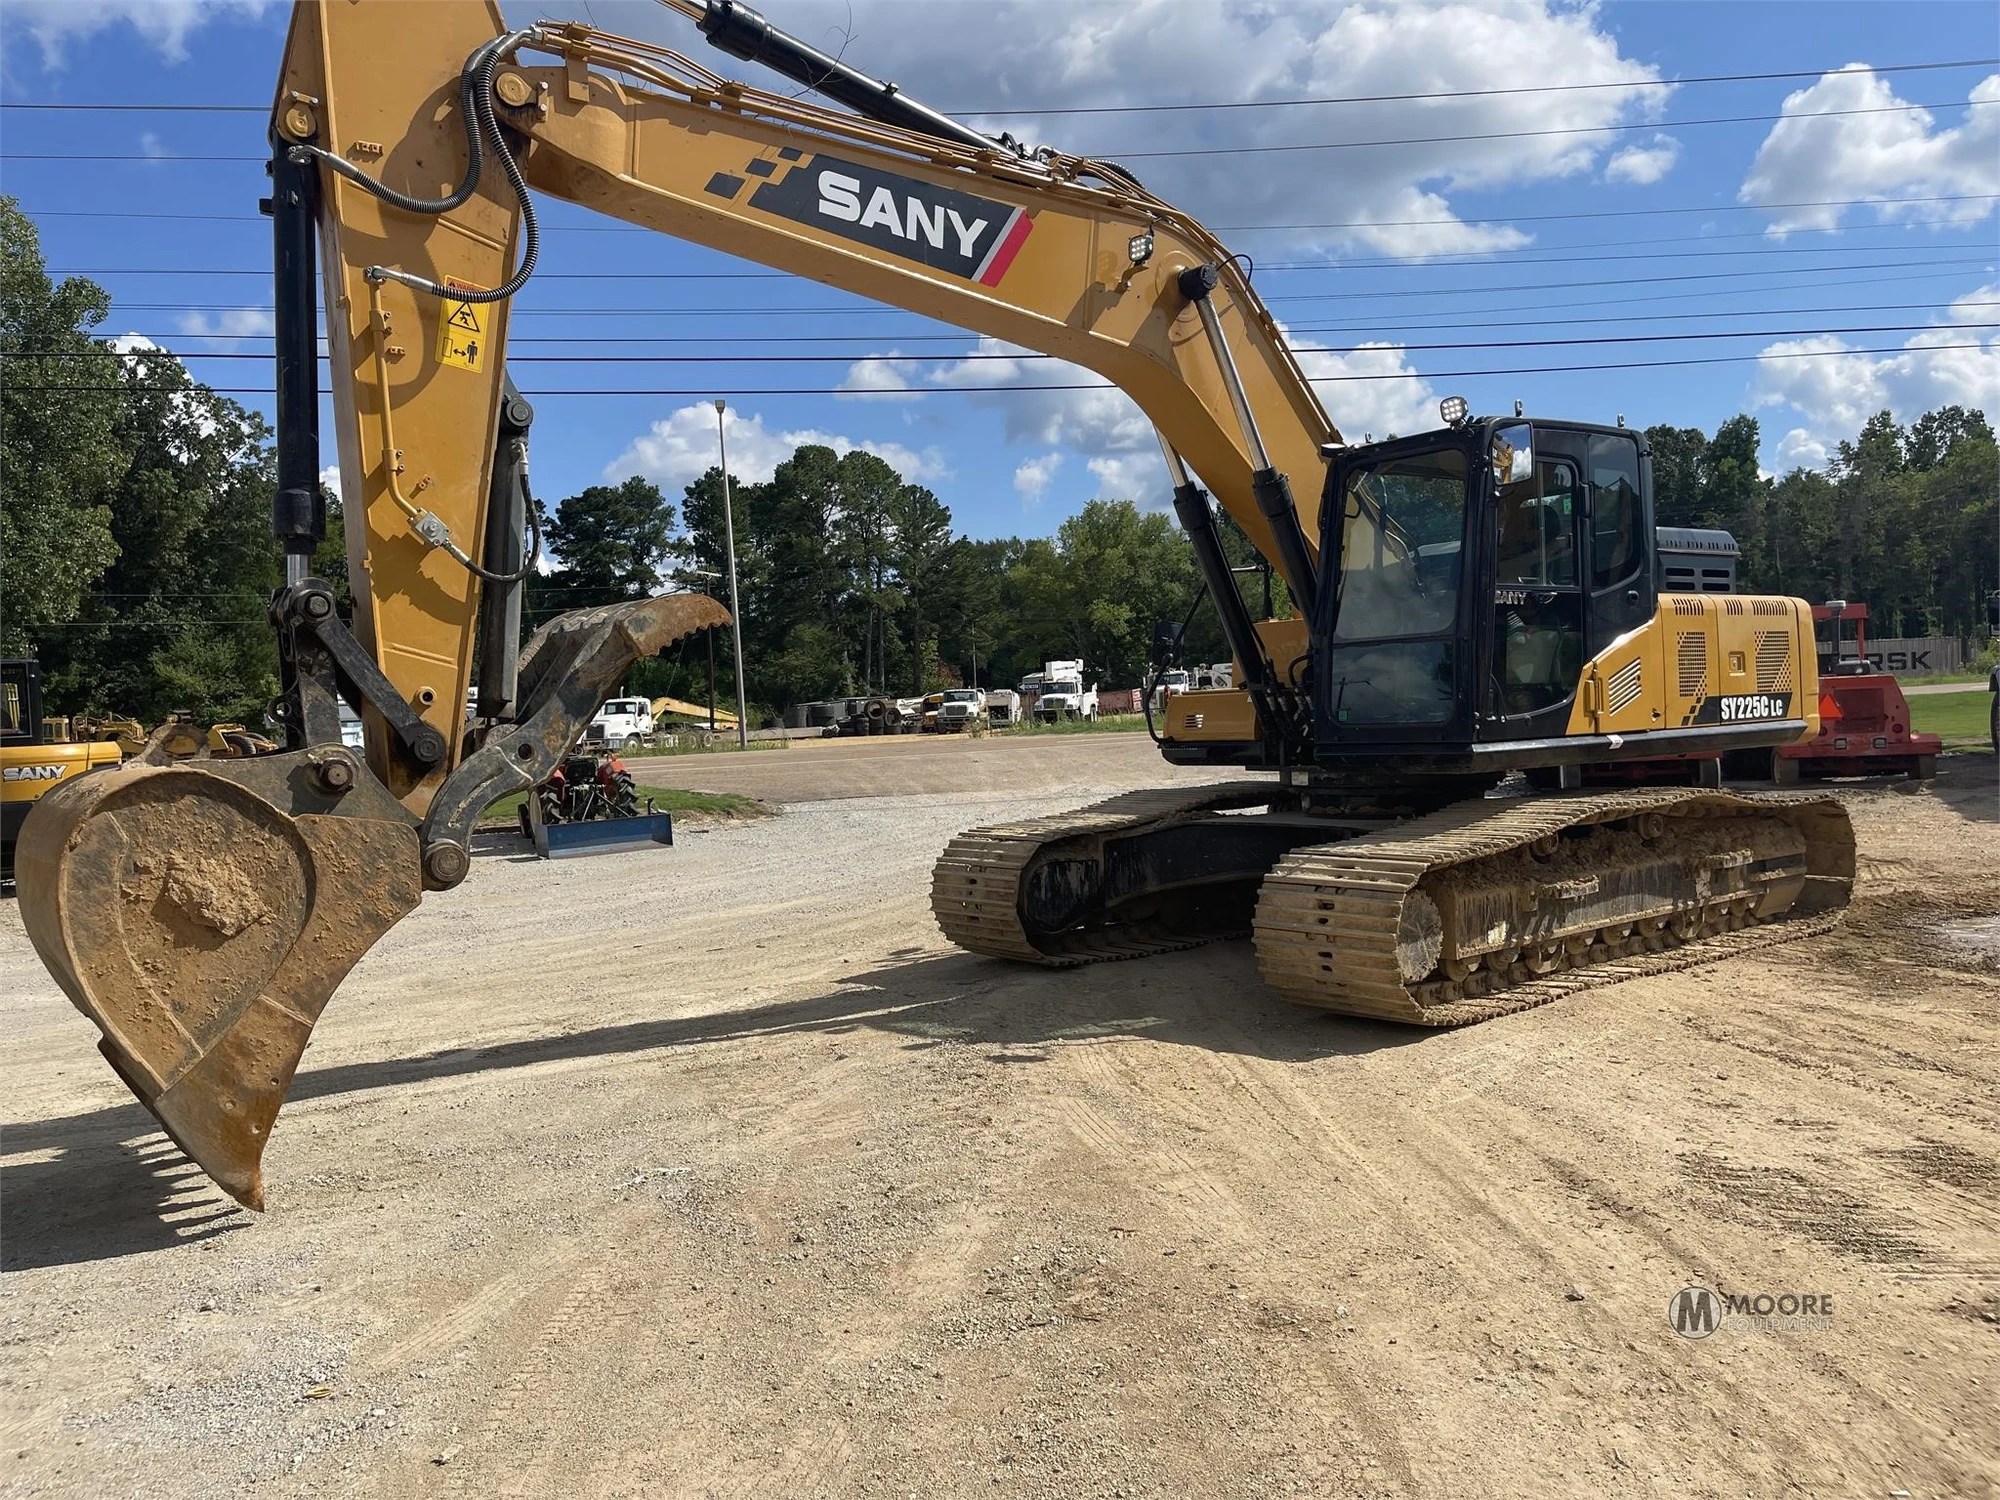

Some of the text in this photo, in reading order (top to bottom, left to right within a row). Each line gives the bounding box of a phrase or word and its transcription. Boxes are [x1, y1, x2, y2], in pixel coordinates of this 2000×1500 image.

[818, 170, 988, 258] SANY
[1720, 695, 1783, 720] SY225C LC
[3, 764, 67, 781] SANY
